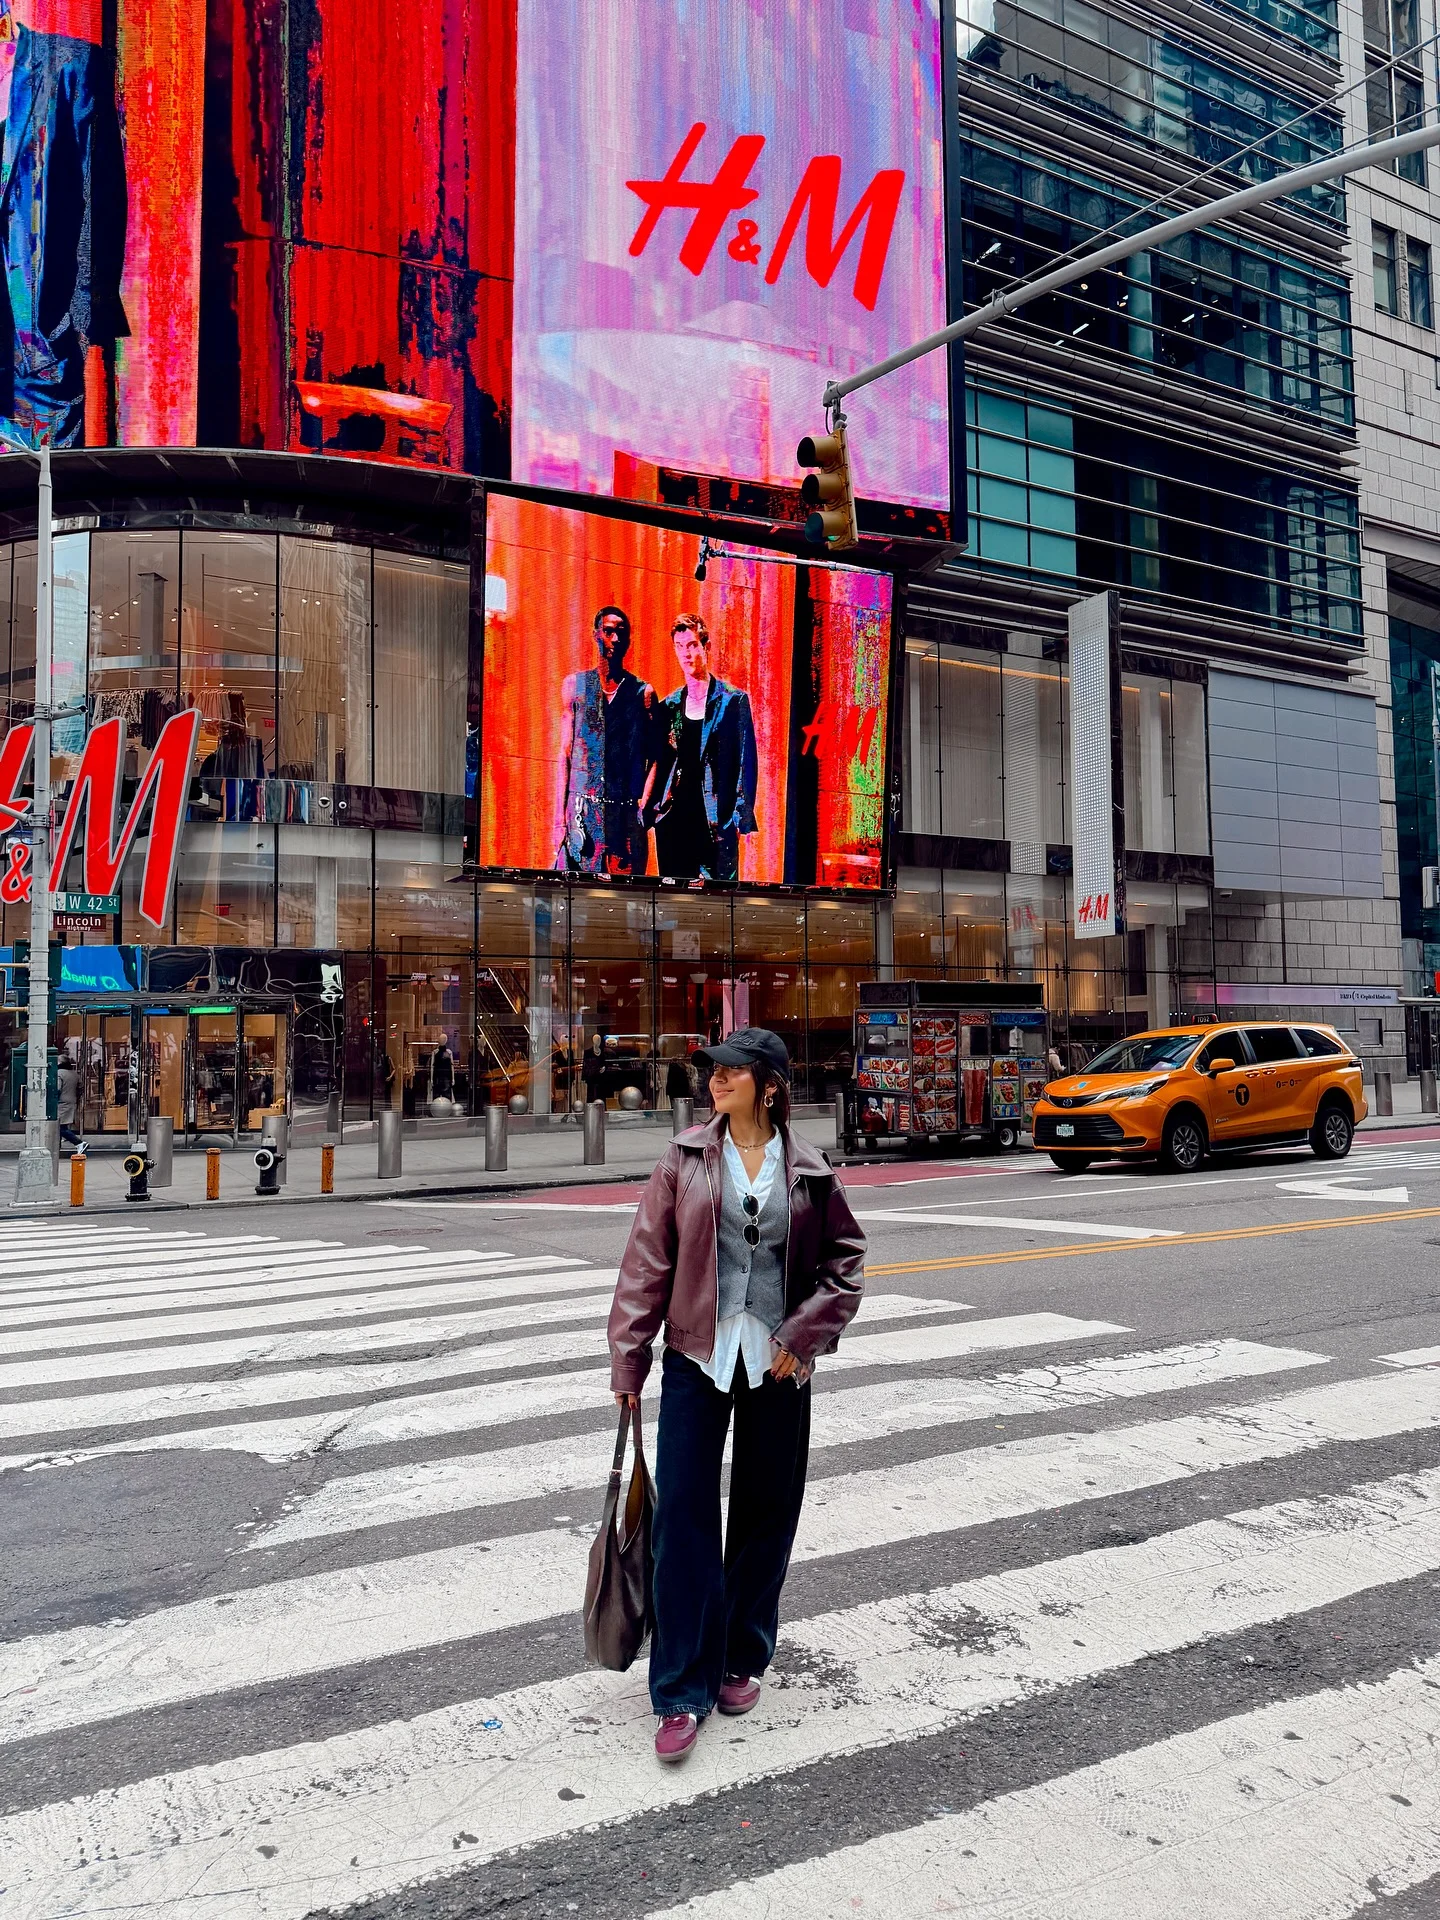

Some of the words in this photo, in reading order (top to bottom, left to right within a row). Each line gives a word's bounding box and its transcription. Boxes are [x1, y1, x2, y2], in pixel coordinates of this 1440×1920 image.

[625, 121, 906, 312] H&M
[801, 701, 878, 766] HM
[56, 915, 101, 926] Lincoln
[69, 895, 81, 910] W
[87, 896, 103, 911] 42
[108, 897, 117, 907] St
